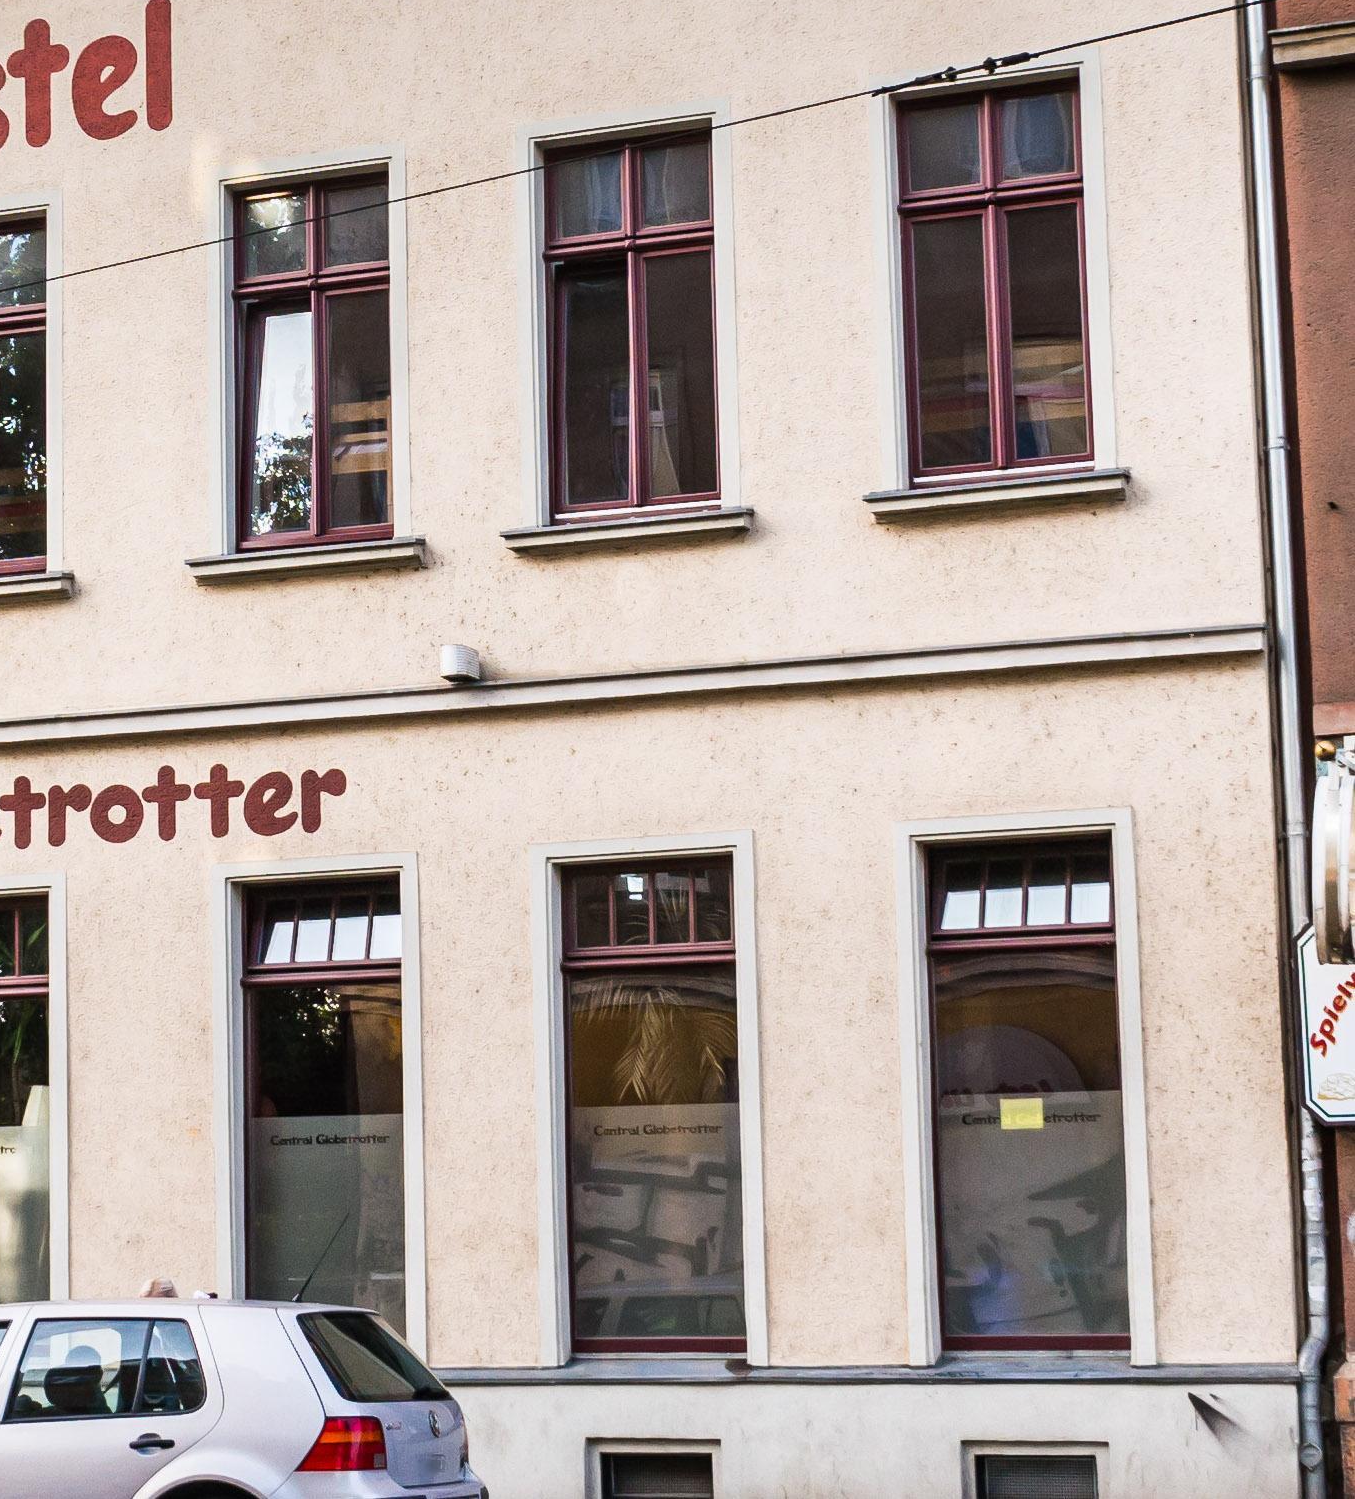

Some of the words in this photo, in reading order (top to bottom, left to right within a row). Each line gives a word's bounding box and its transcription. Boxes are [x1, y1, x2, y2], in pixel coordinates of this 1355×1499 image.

[594, 1124, 640, 1136] Central
[644, 1123, 723, 1135] Globetrotter
[270, 1135, 313, 1146] Central
[316, 1133, 390, 1145] Globetrotter
